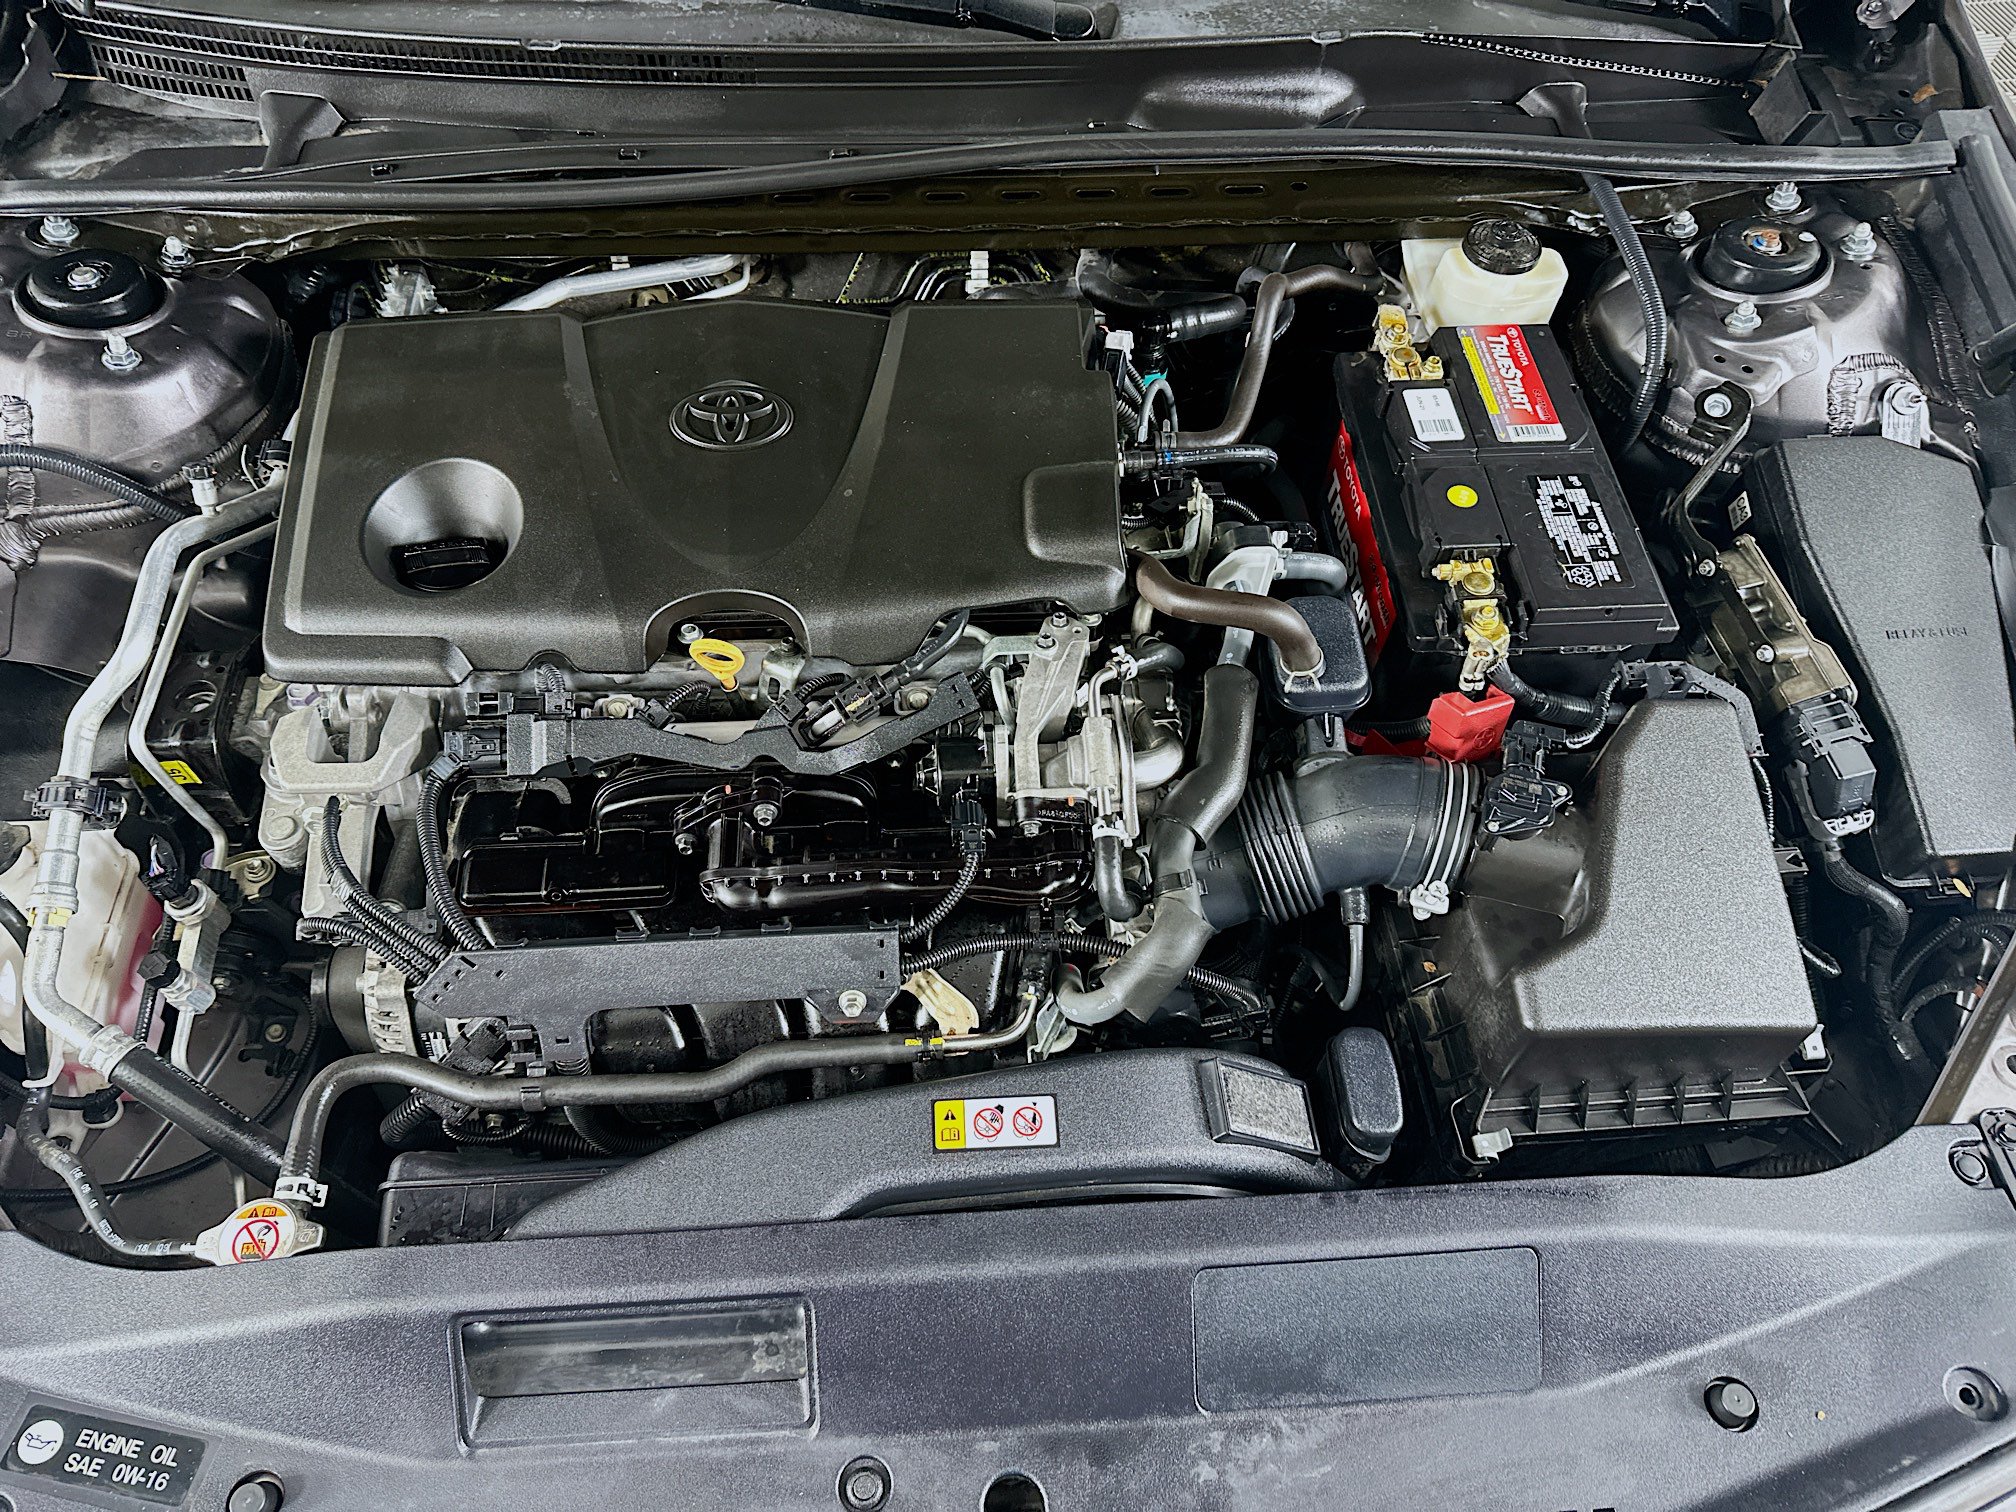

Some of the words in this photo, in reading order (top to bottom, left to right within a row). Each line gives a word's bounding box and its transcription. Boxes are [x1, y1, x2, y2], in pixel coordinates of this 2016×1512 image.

[1512, 337, 1530, 367] TOYOTA
[1343, 457, 1361, 521] TOYOTA
[1736, 496, 1749, 521] CA3
[75, 1428, 144, 1459] ENGINE
[149, 1445, 178, 1468] OIL
[63, 1452, 105, 1477] SAE
[111, 1463, 170, 1492] 0W-16
